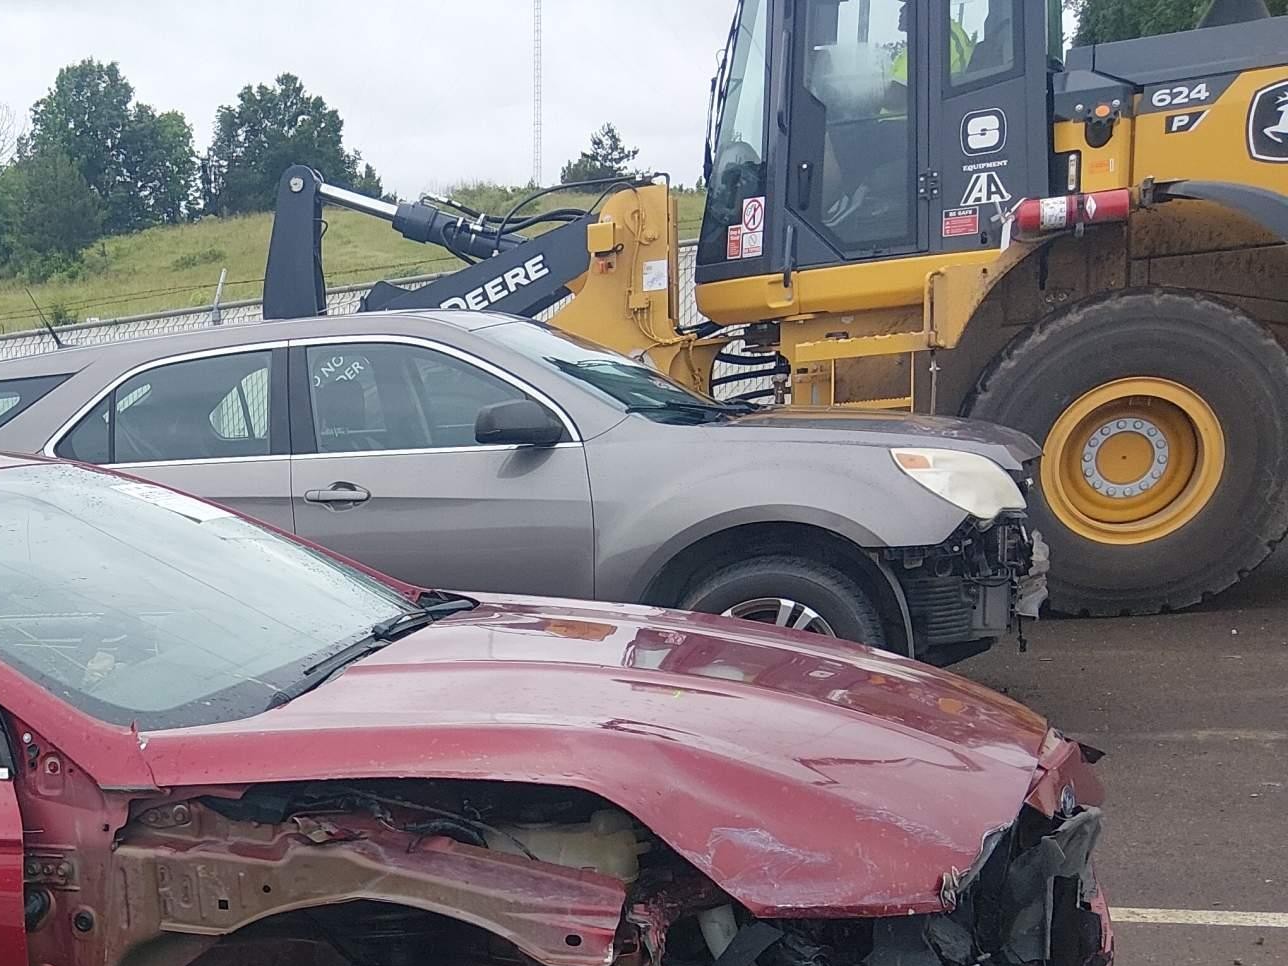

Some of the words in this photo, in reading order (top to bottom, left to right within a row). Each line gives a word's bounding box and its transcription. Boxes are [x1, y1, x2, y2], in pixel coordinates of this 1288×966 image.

[1152, 83, 1210, 107] 624
[1172, 115, 1190, 131] P
[962, 160, 1008, 171] EQUIPMENT
